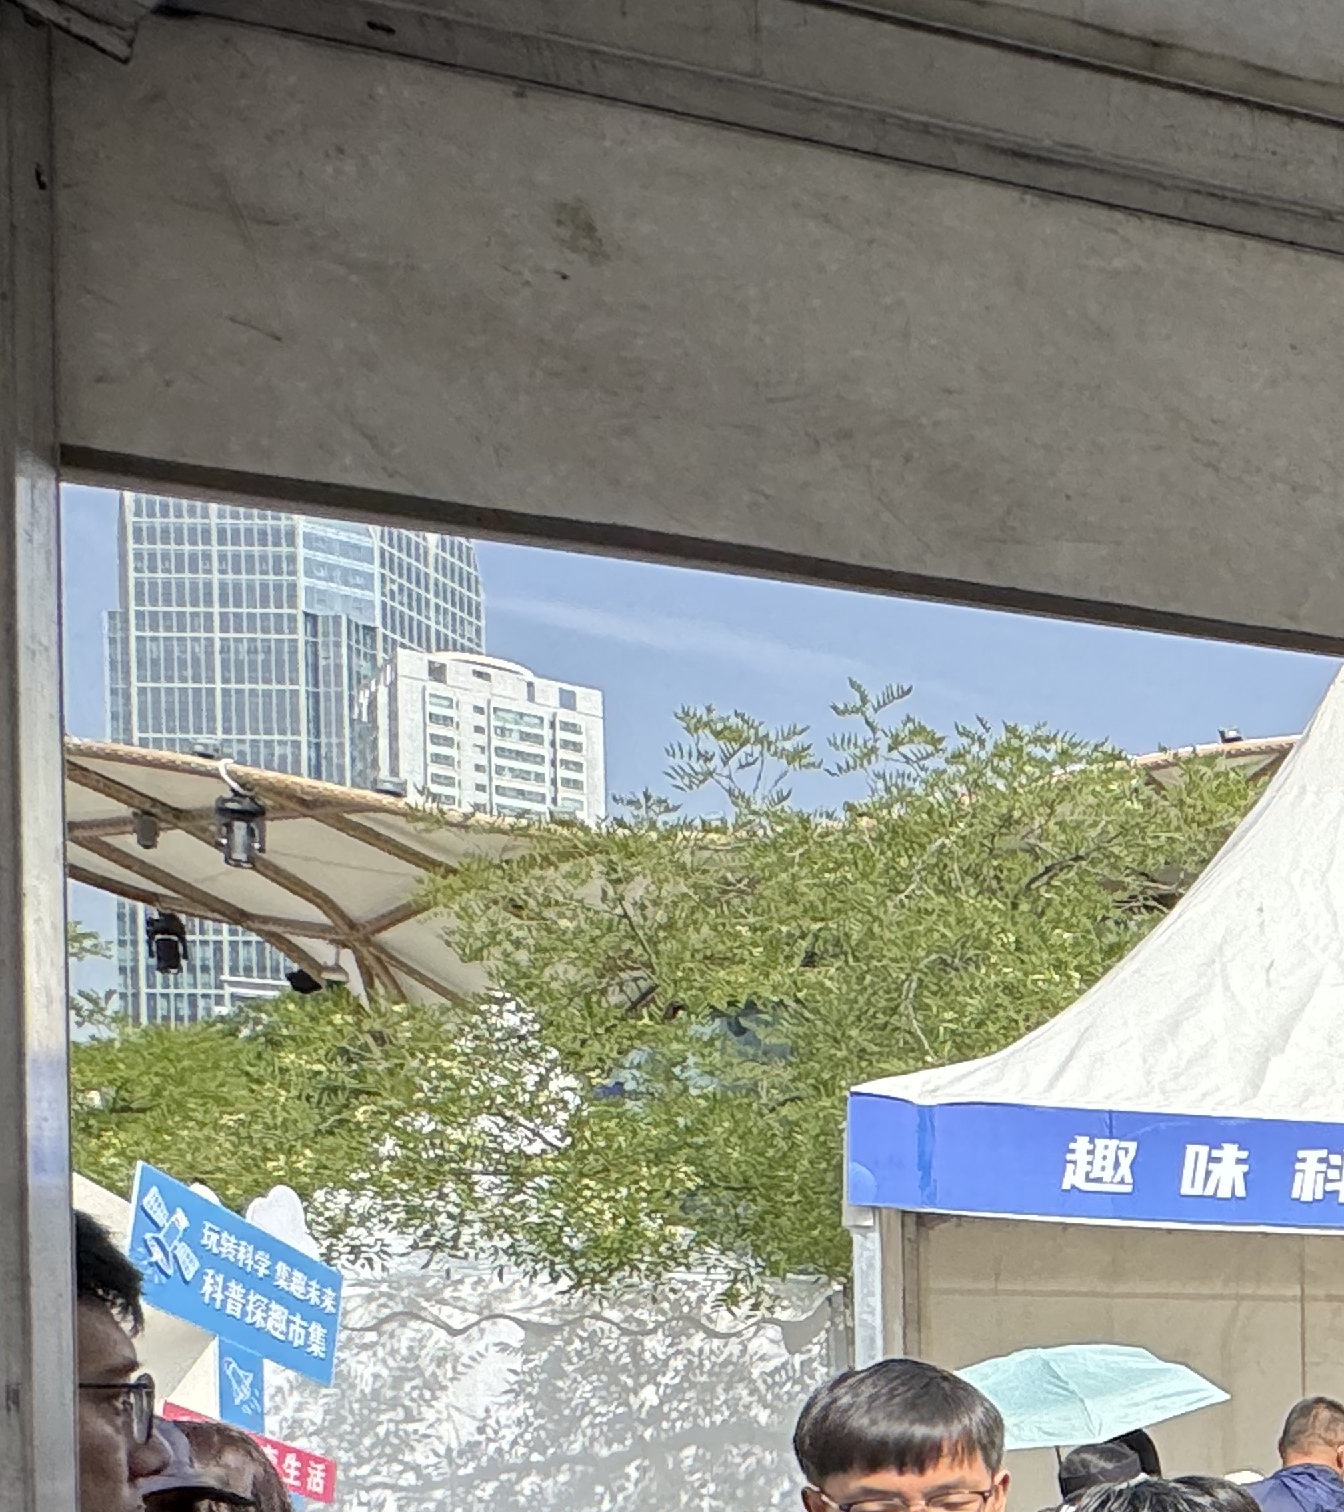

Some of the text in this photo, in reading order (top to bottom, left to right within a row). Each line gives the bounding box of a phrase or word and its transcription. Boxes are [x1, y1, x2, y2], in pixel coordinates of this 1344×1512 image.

[200, 1268, 328, 1360] 科普探趣市集
